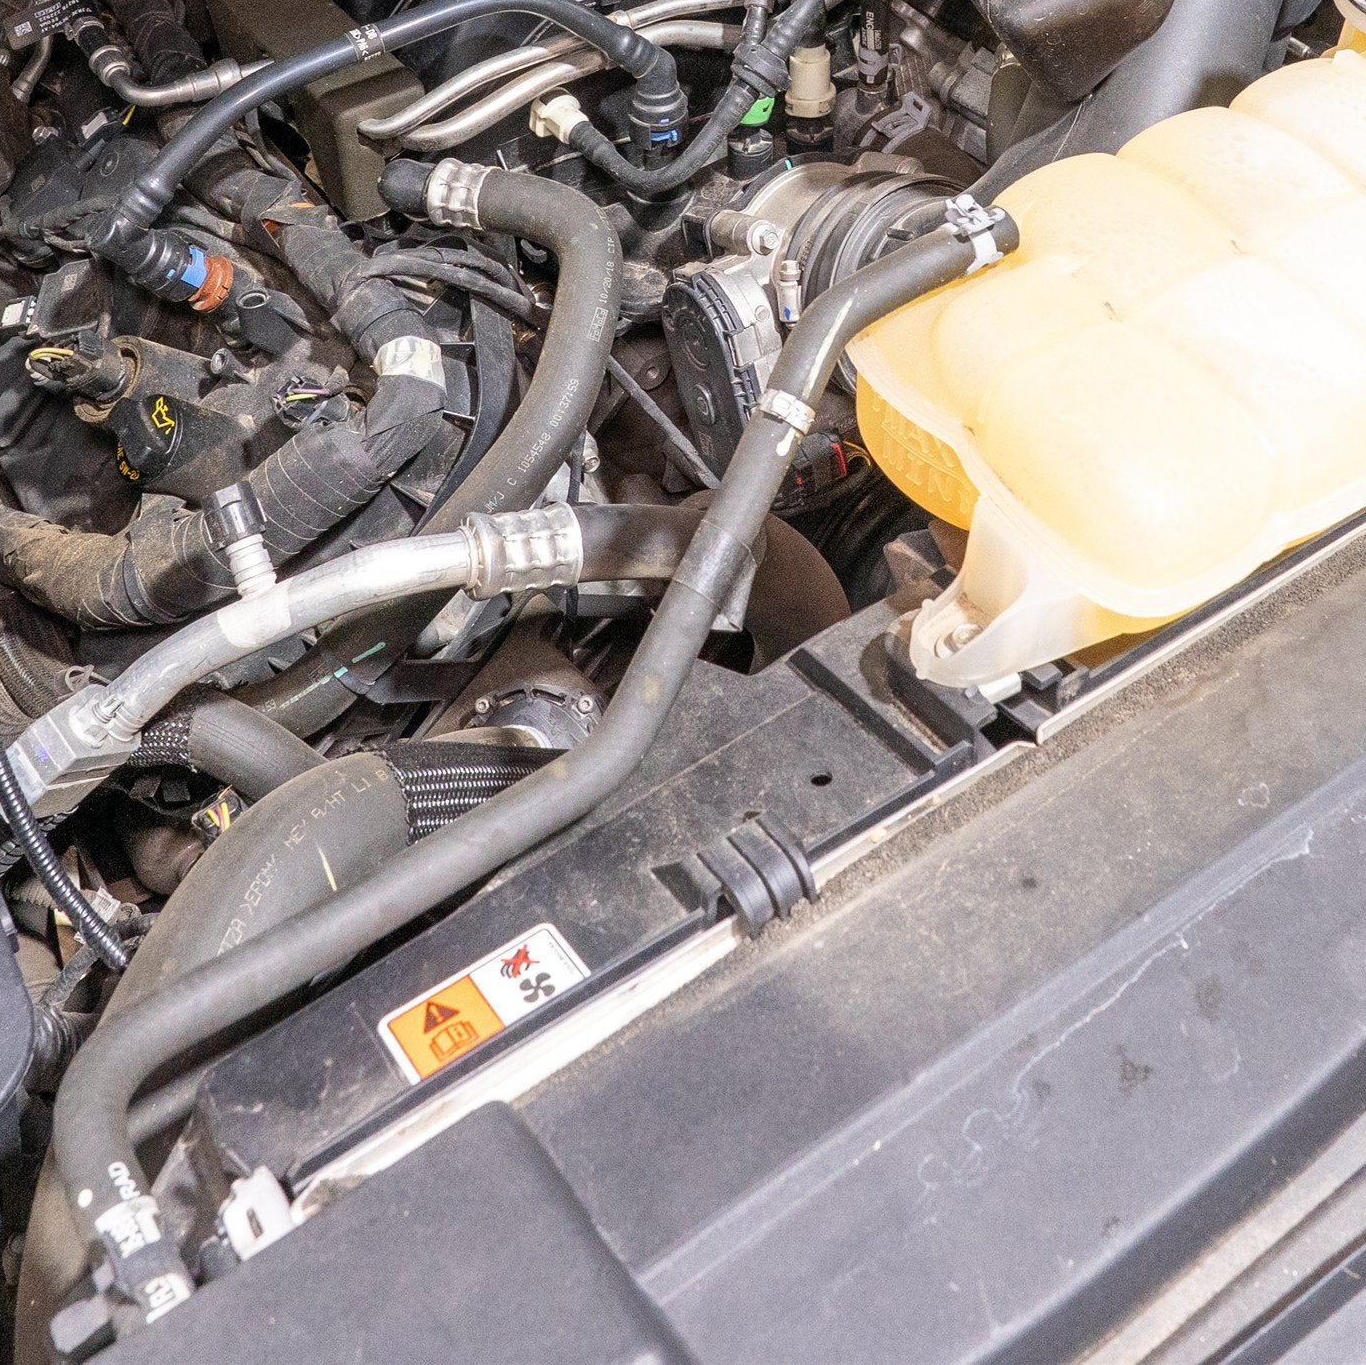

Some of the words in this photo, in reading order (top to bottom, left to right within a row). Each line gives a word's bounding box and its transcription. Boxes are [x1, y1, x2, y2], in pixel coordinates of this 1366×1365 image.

[866, 11, 874, 30] ENG
[599, 261, 615, 304] 10/20/18
[108, 1161, 141, 1201] RAD
